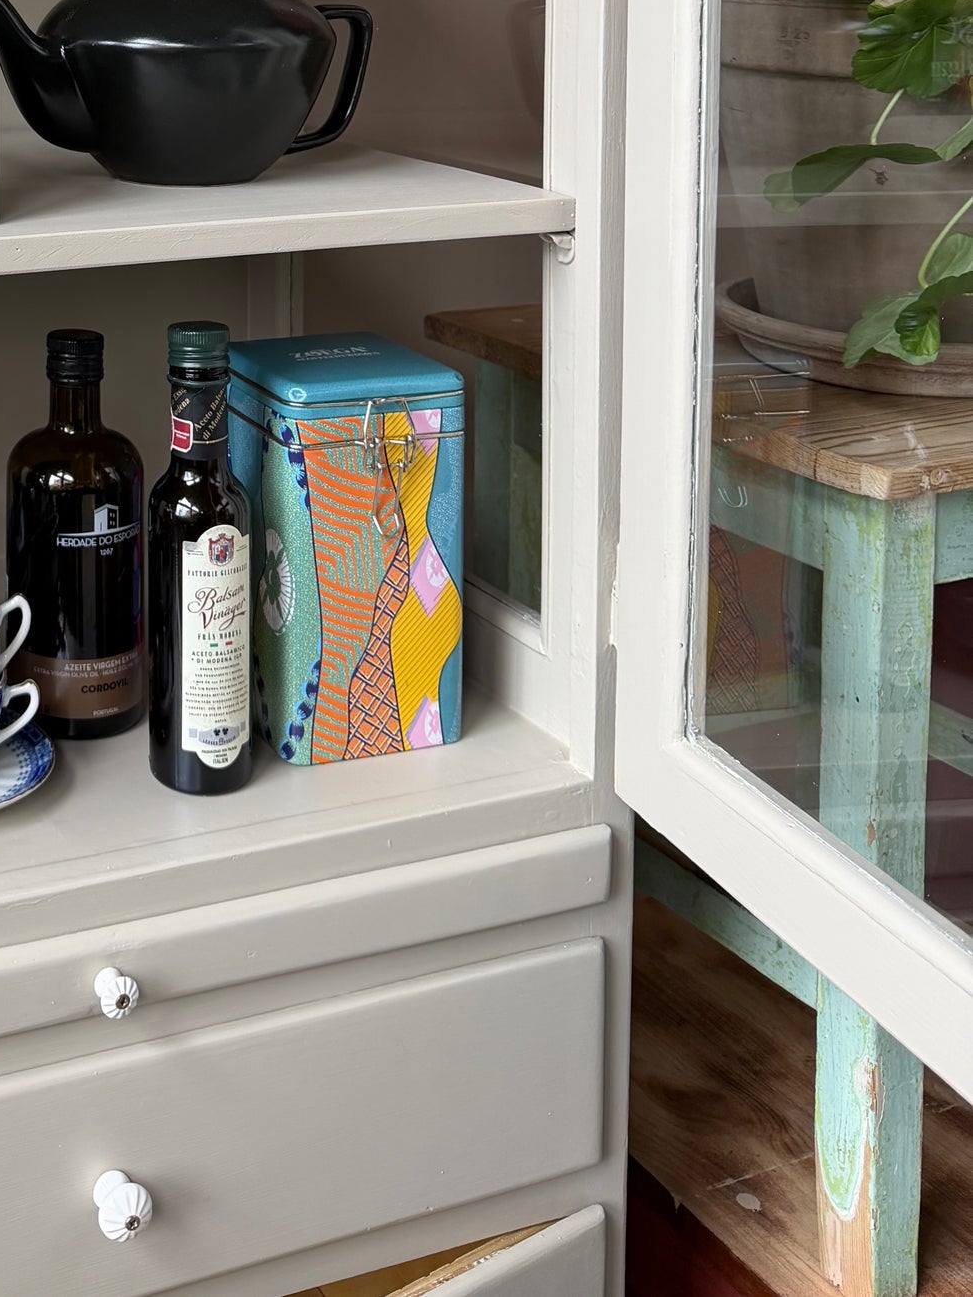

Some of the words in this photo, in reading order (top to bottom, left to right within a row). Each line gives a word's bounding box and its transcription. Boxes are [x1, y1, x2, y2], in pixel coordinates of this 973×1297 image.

[194, 411, 213, 432] Aceto
[57, 537, 97, 547] HERDADE
[99, 536, 112, 546] DO
[187, 584, 245, 613] Balsam
[199, 597, 247, 631] Vinäger
[215, 644, 245, 656] BALSAMICO
[64, 663, 92, 671] AZEITE
[93, 660, 121, 670] VIRGEM
[81, 678, 128, 694] CORDOVIL
[93, 707, 119, 716] PORTUGAL
